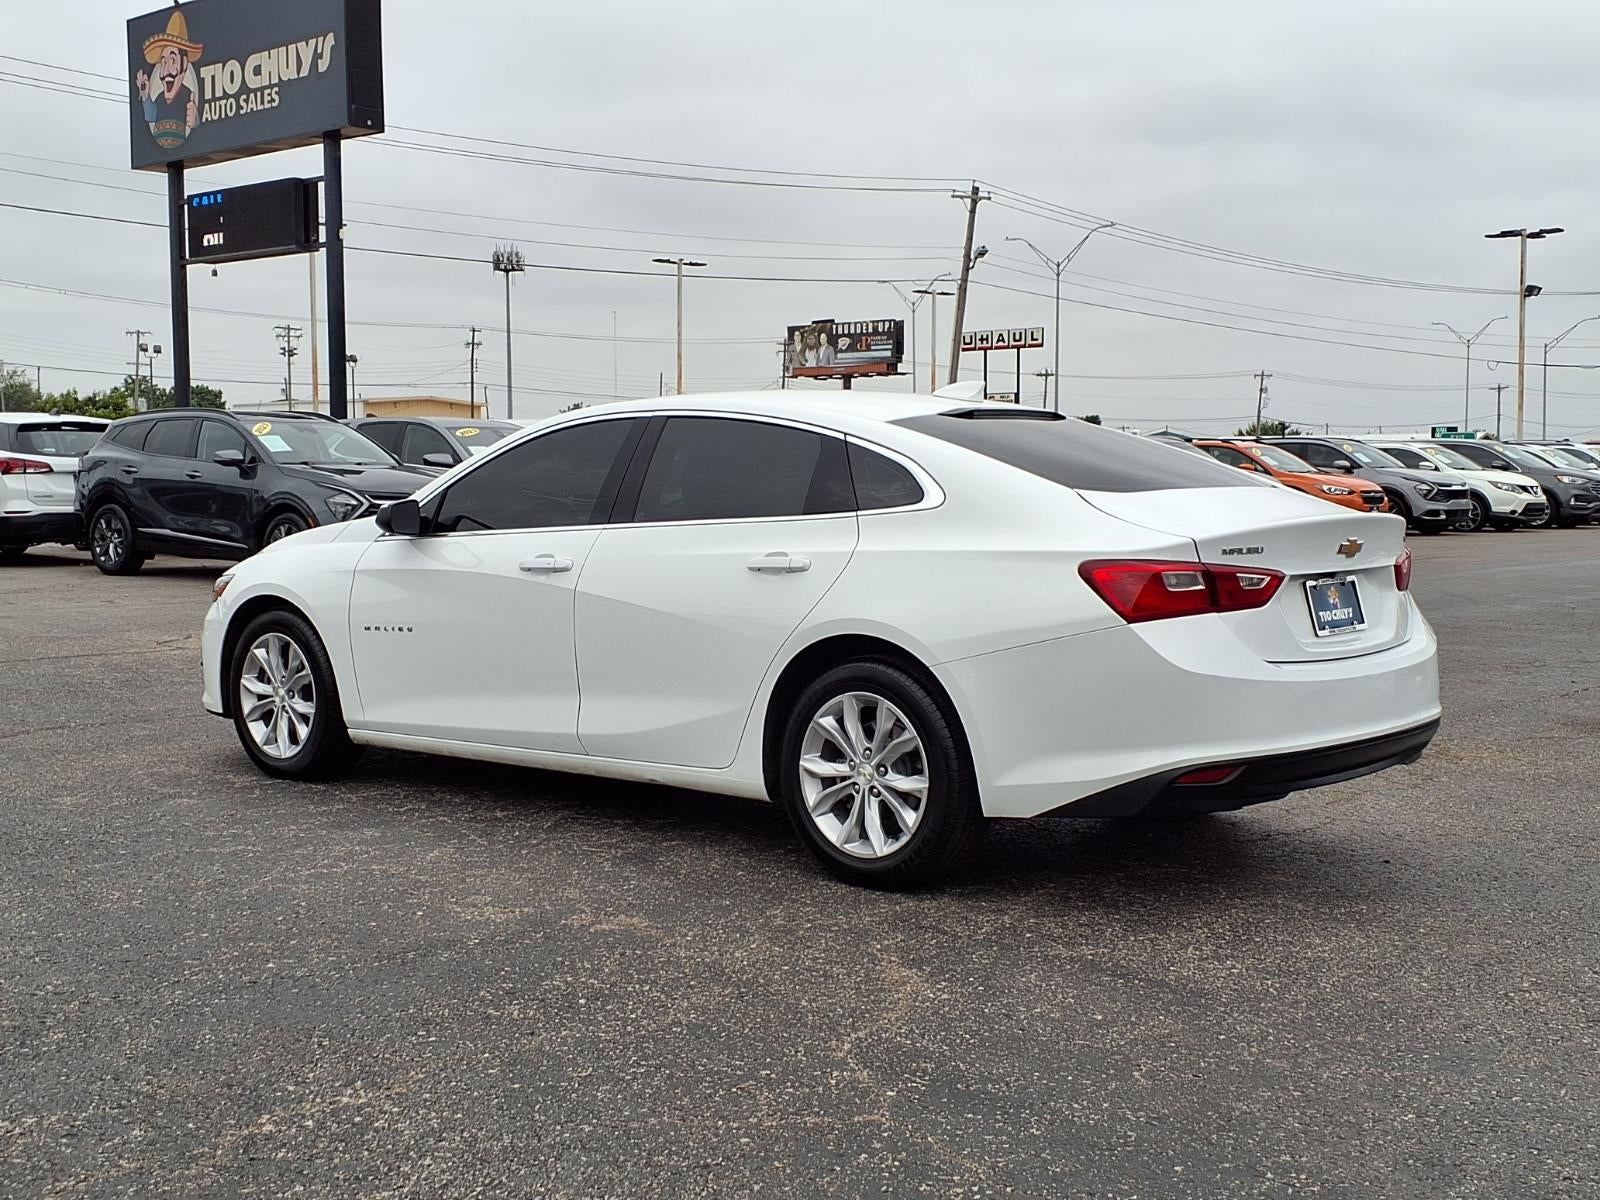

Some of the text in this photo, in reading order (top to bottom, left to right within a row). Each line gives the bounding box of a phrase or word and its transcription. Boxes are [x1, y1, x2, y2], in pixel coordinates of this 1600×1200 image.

[200, 32, 335, 99] TIO CHUY'S
[202, 87, 280, 123] AUTO SALES
[832, 320, 894, 335] THUNDER UP!
[1221, 546, 1264, 556] MALIBU
[1319, 611, 1332, 623] TIO
[364, 625, 413, 633] MALIBU
